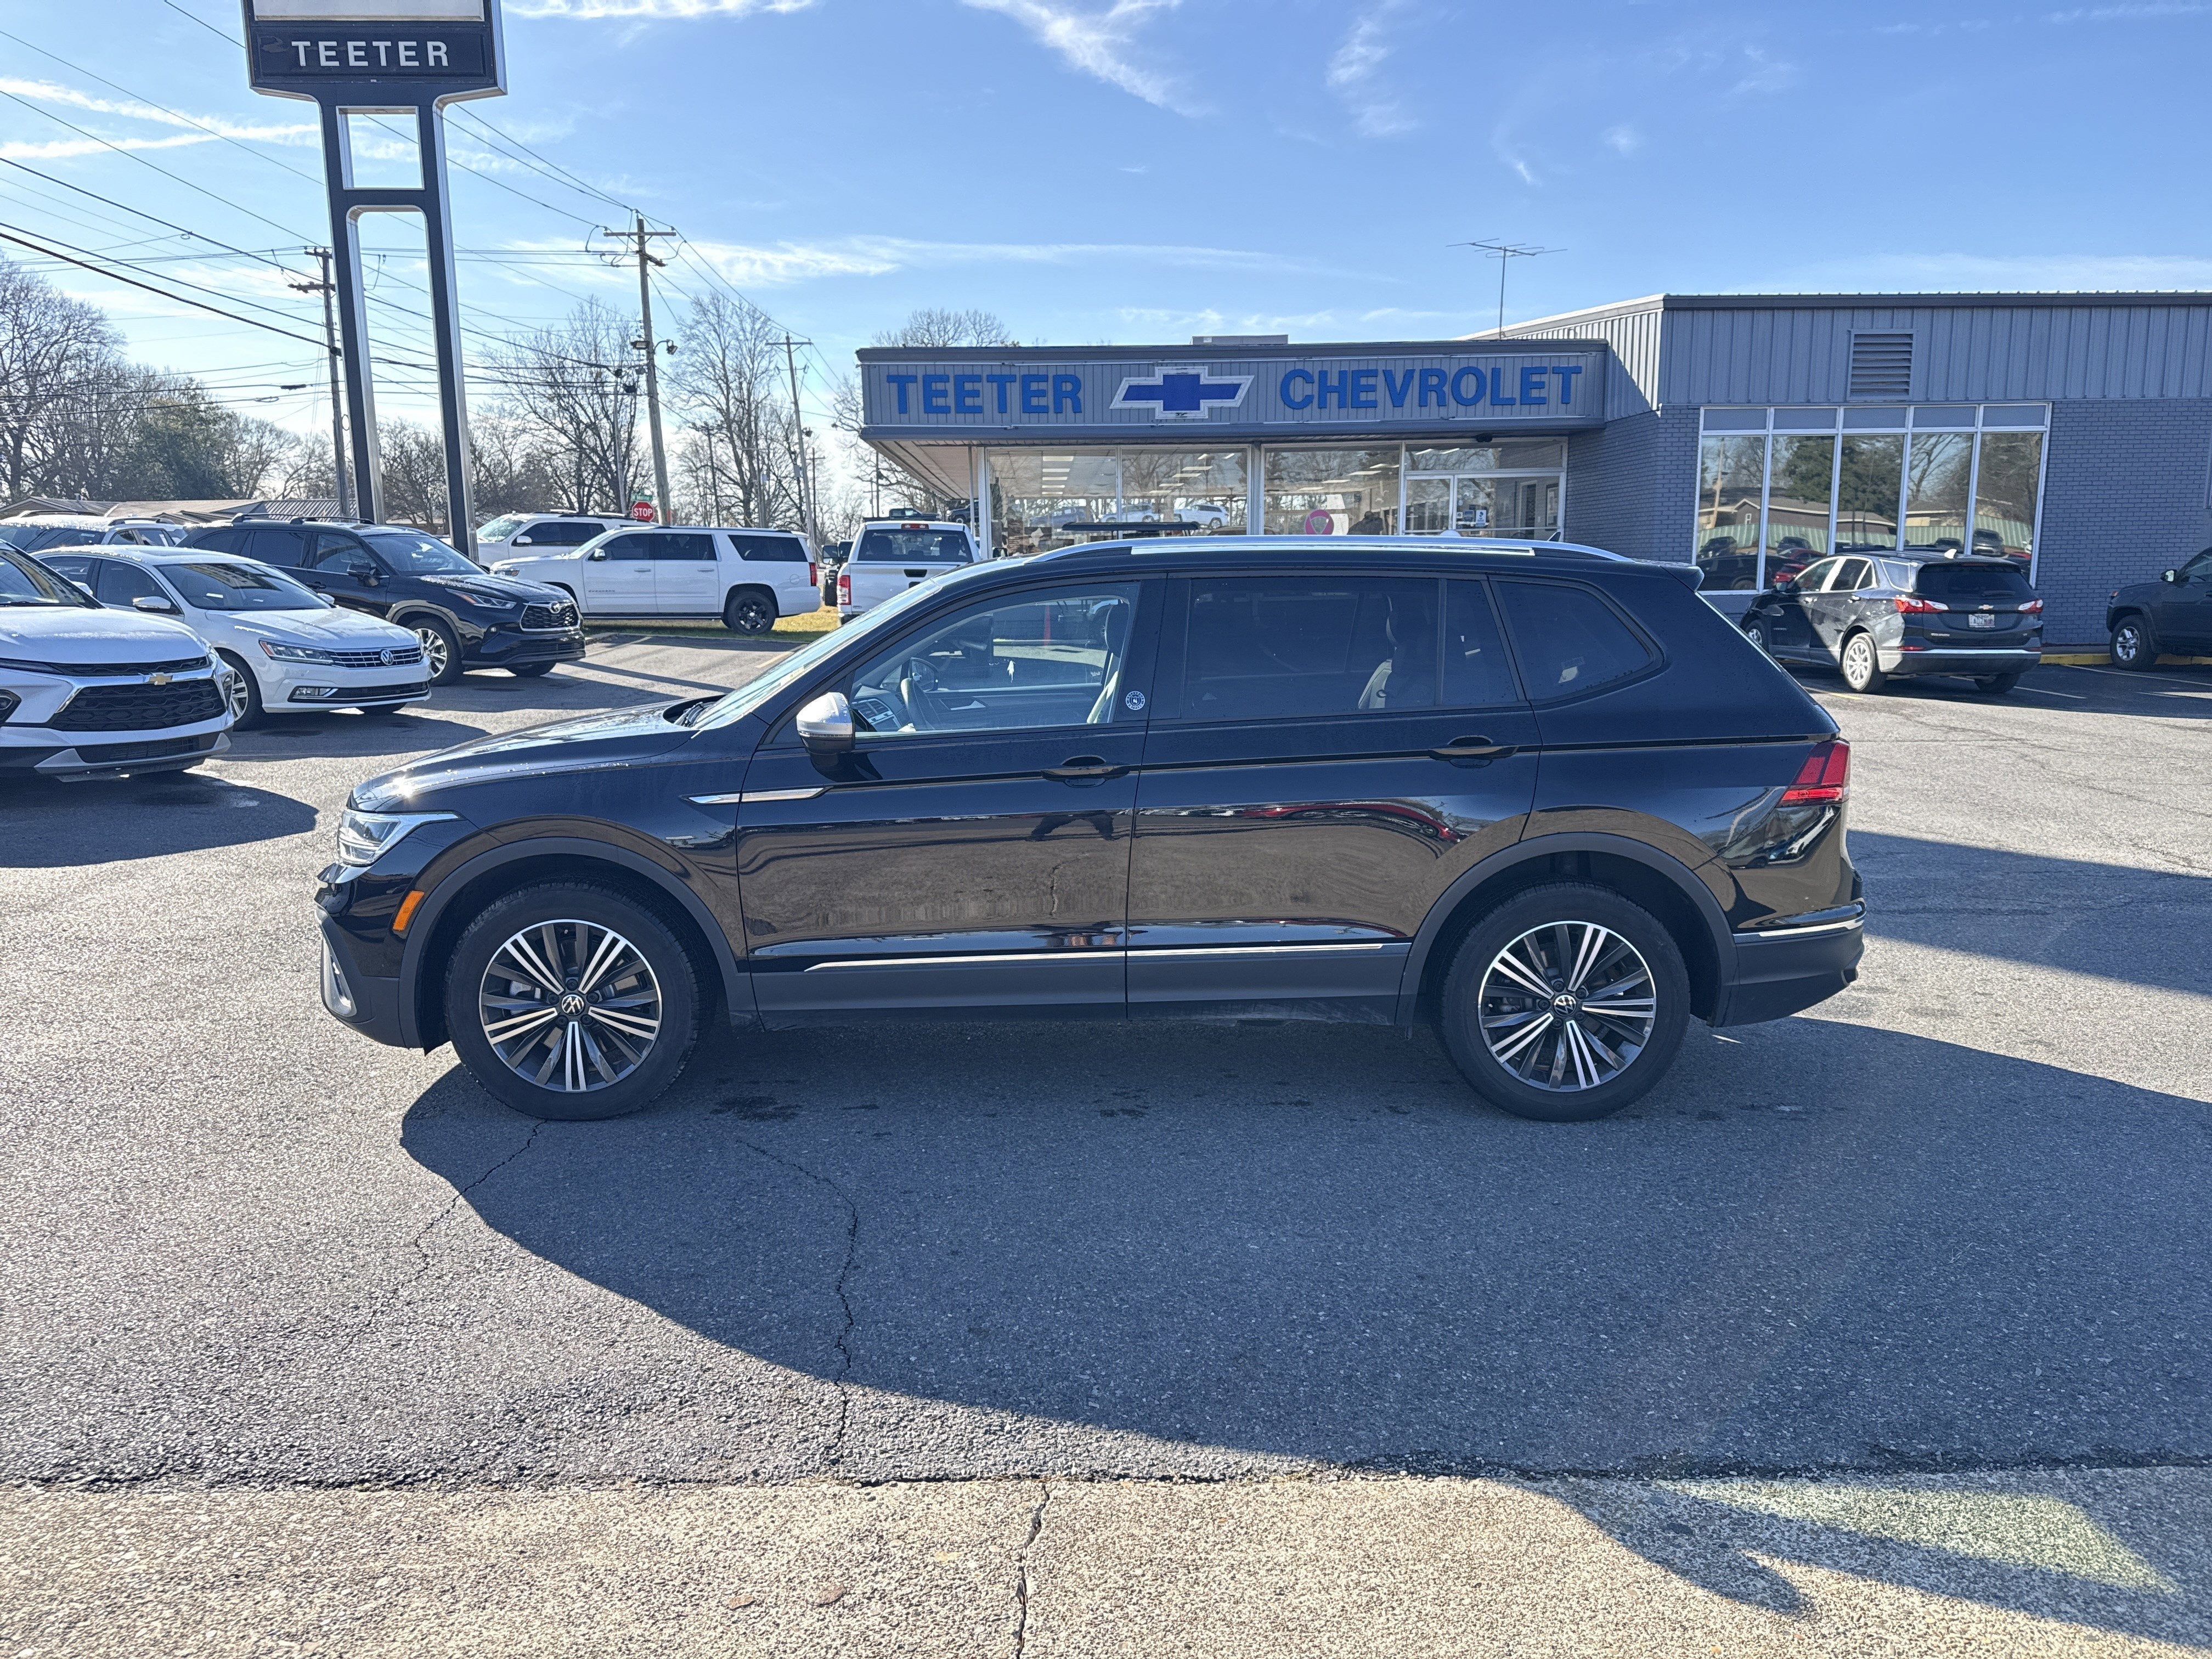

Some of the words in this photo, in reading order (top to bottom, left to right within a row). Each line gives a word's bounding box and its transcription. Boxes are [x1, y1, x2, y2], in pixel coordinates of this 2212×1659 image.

[291, 41, 449, 67] TEETER
[887, 374, 1082, 414] TEETER
[1280, 365, 1582, 410] CHEVROLET
[634, 508, 653, 517] STOP
